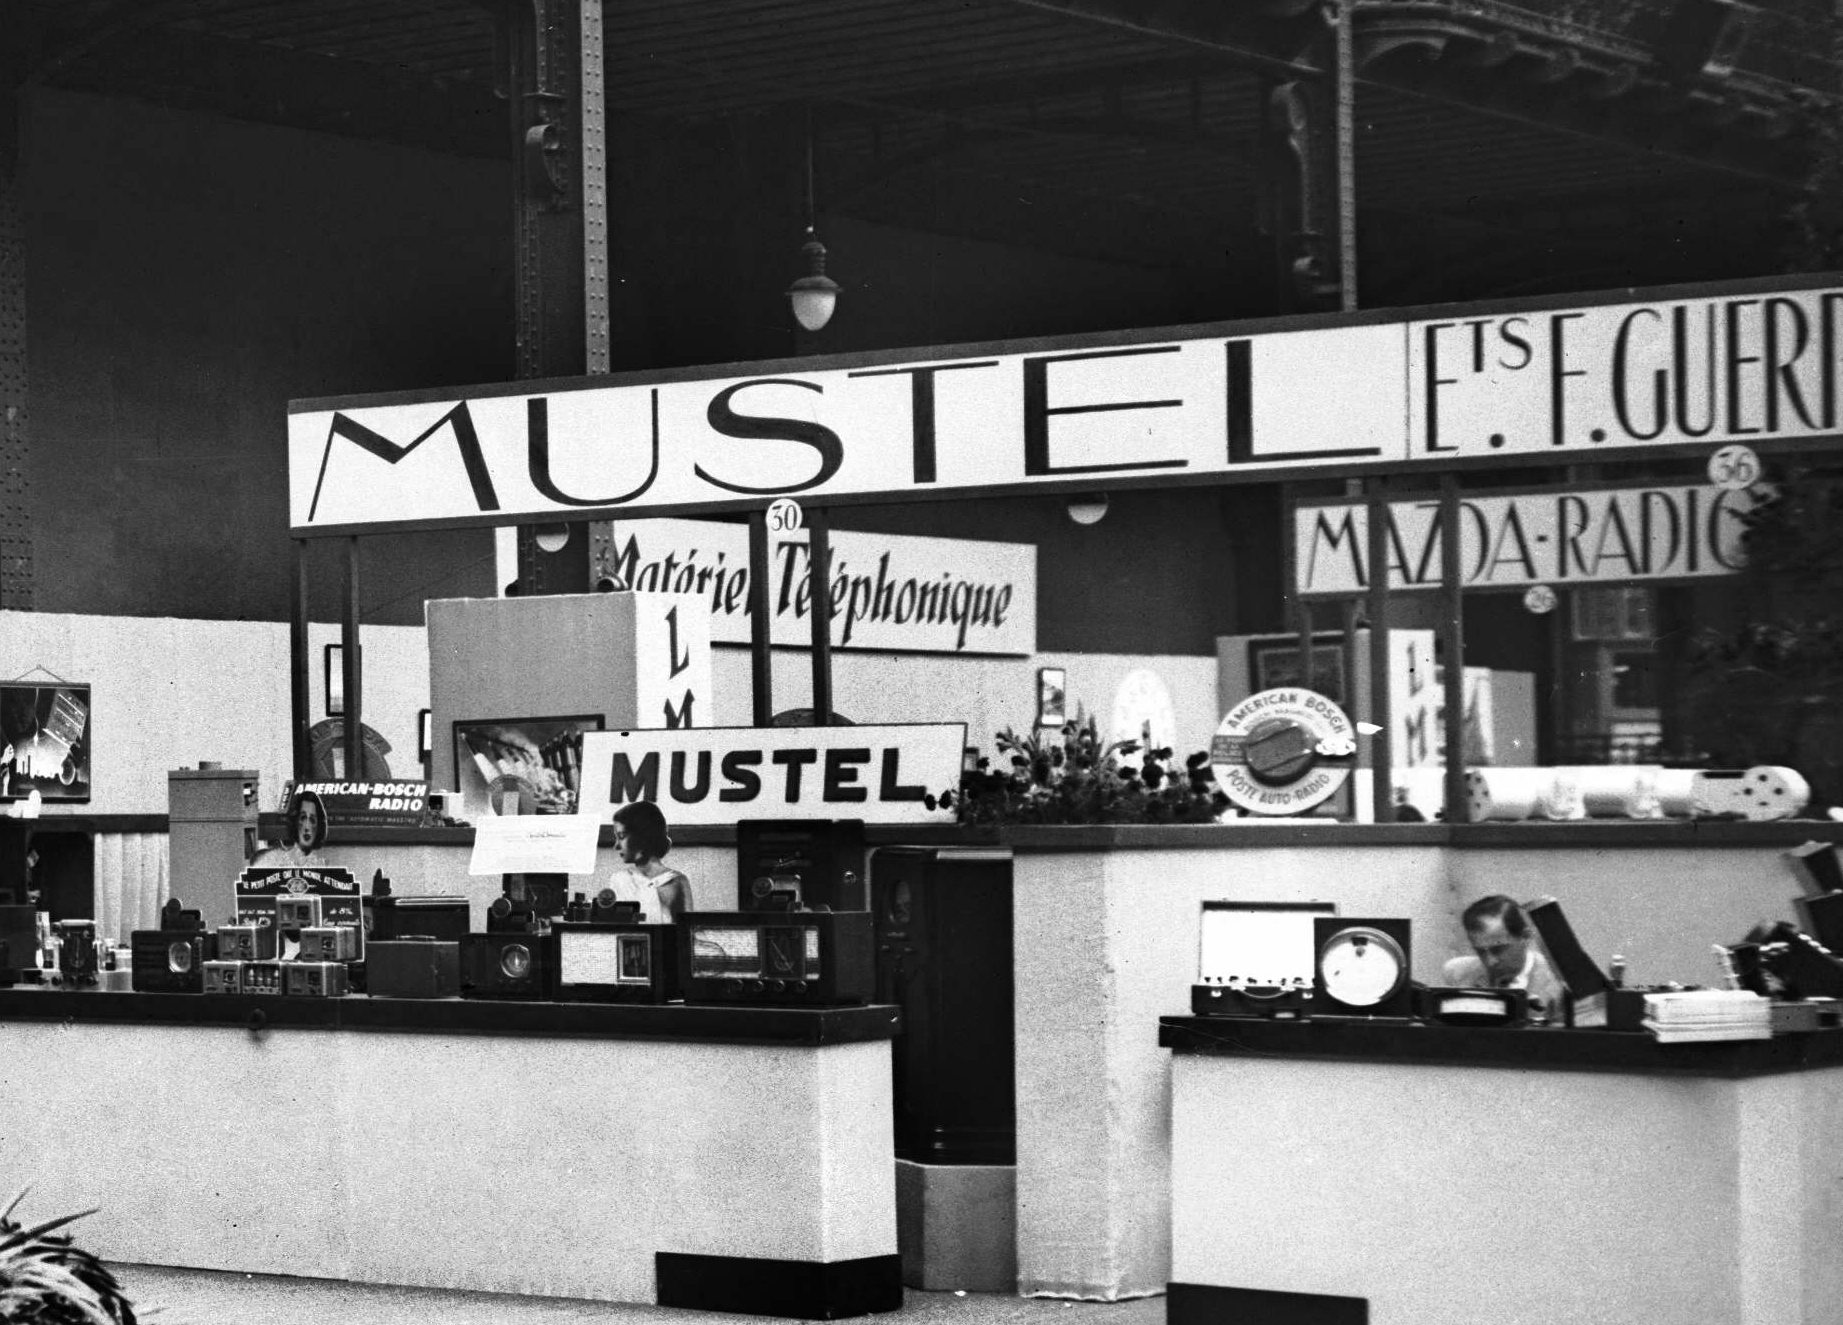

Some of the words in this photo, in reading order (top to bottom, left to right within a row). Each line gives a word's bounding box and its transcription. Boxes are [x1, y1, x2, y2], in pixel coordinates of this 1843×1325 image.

[308, 338, 1381, 523] MUSTEL
[771, 504, 799, 532] 30
[614, 532, 752, 617] Matérie
[775, 540, 1013, 652] Tééphonique
[1226, 693, 1299, 730] AMERICAN
[1304, 695, 1347, 735] BOSCH
[294, 781, 427, 797] AMERICAN-BOSCH
[610, 747, 928, 804] MUSTEL
[1225, 768, 1259, 800] POSTE
[369, 797, 424, 812] RADIO
